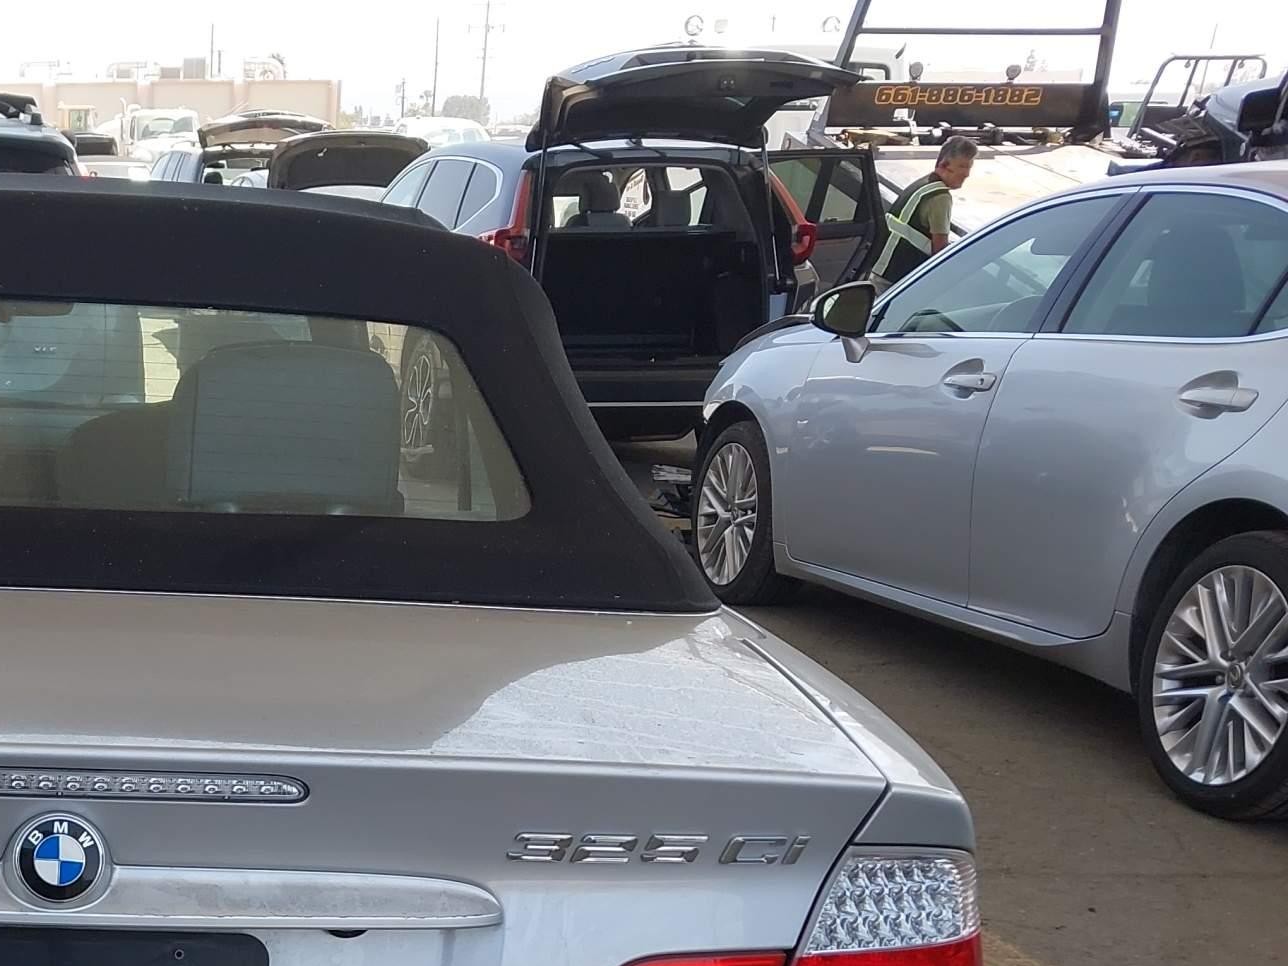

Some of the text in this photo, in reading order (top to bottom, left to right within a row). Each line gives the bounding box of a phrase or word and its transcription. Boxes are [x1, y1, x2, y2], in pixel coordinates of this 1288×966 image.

[875, 85, 1043, 106] 661-886-1882
[28, 821, 95, 849] BMW
[506, 832, 710, 865] 325
